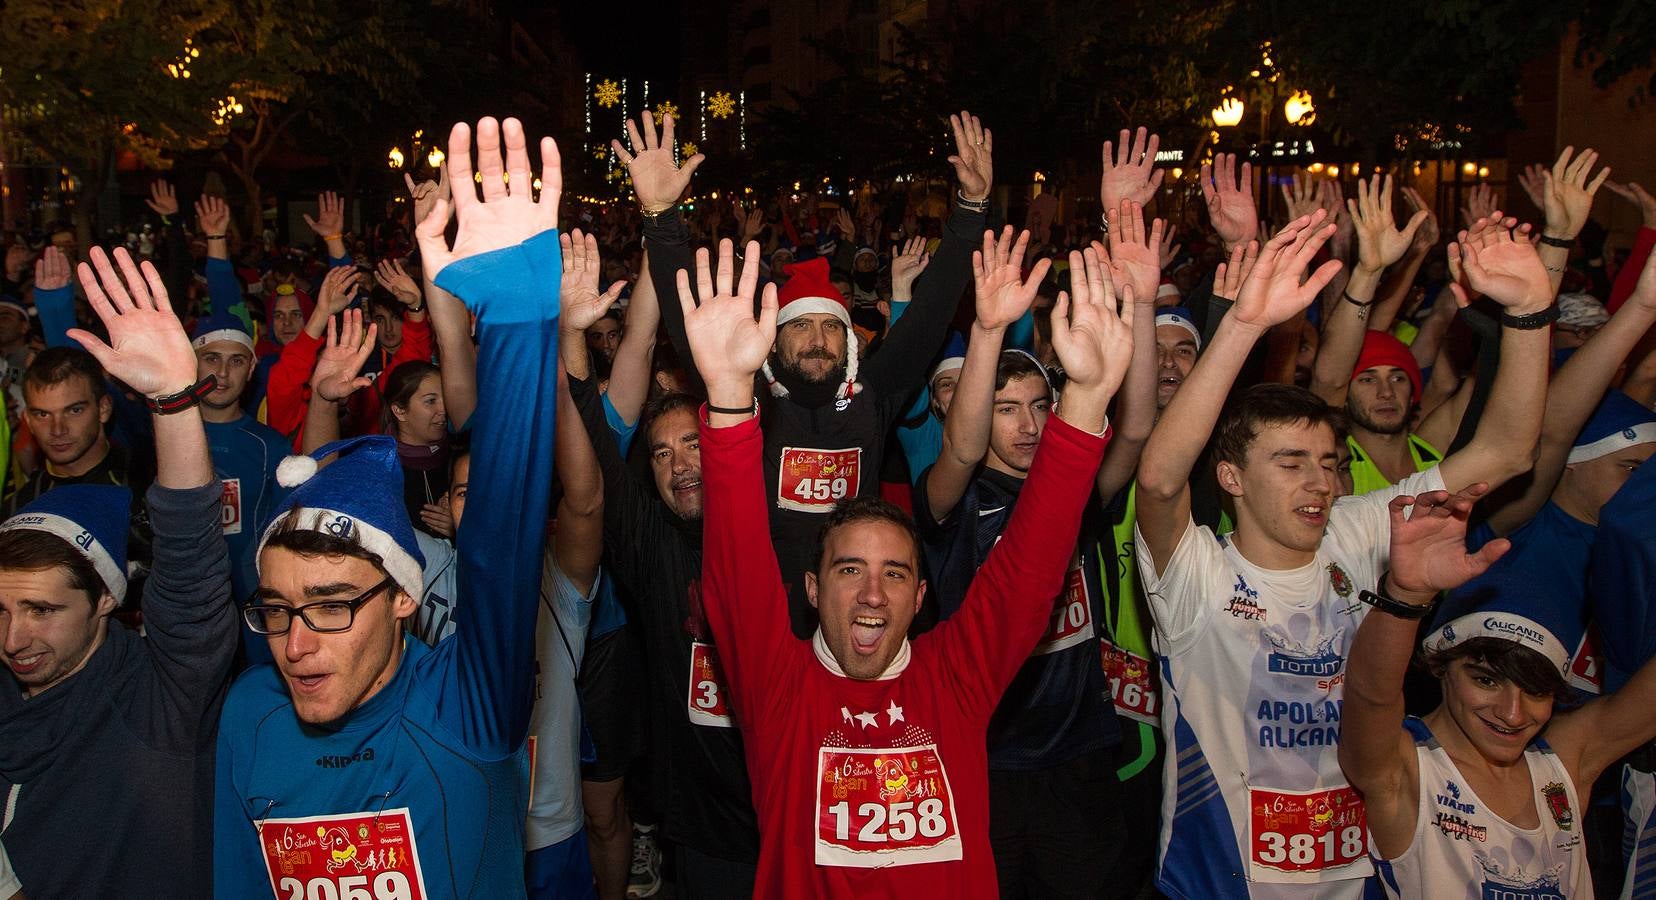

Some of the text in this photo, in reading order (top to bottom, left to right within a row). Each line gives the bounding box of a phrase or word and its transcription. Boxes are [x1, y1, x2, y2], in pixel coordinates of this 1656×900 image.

[794, 477, 848, 501] 459
[221, 504, 236, 525] 0
[1053, 601, 1086, 634] 70
[1583, 655, 1597, 678] 1
[696, 680, 719, 709] 3
[1103, 671, 1157, 714] 161
[1317, 673, 1345, 693] spor
[1259, 725, 1343, 748] ALICAN
[828, 797, 948, 843] 1258
[1259, 825, 1363, 866] 3818
[279, 871, 413, 900] 2059
